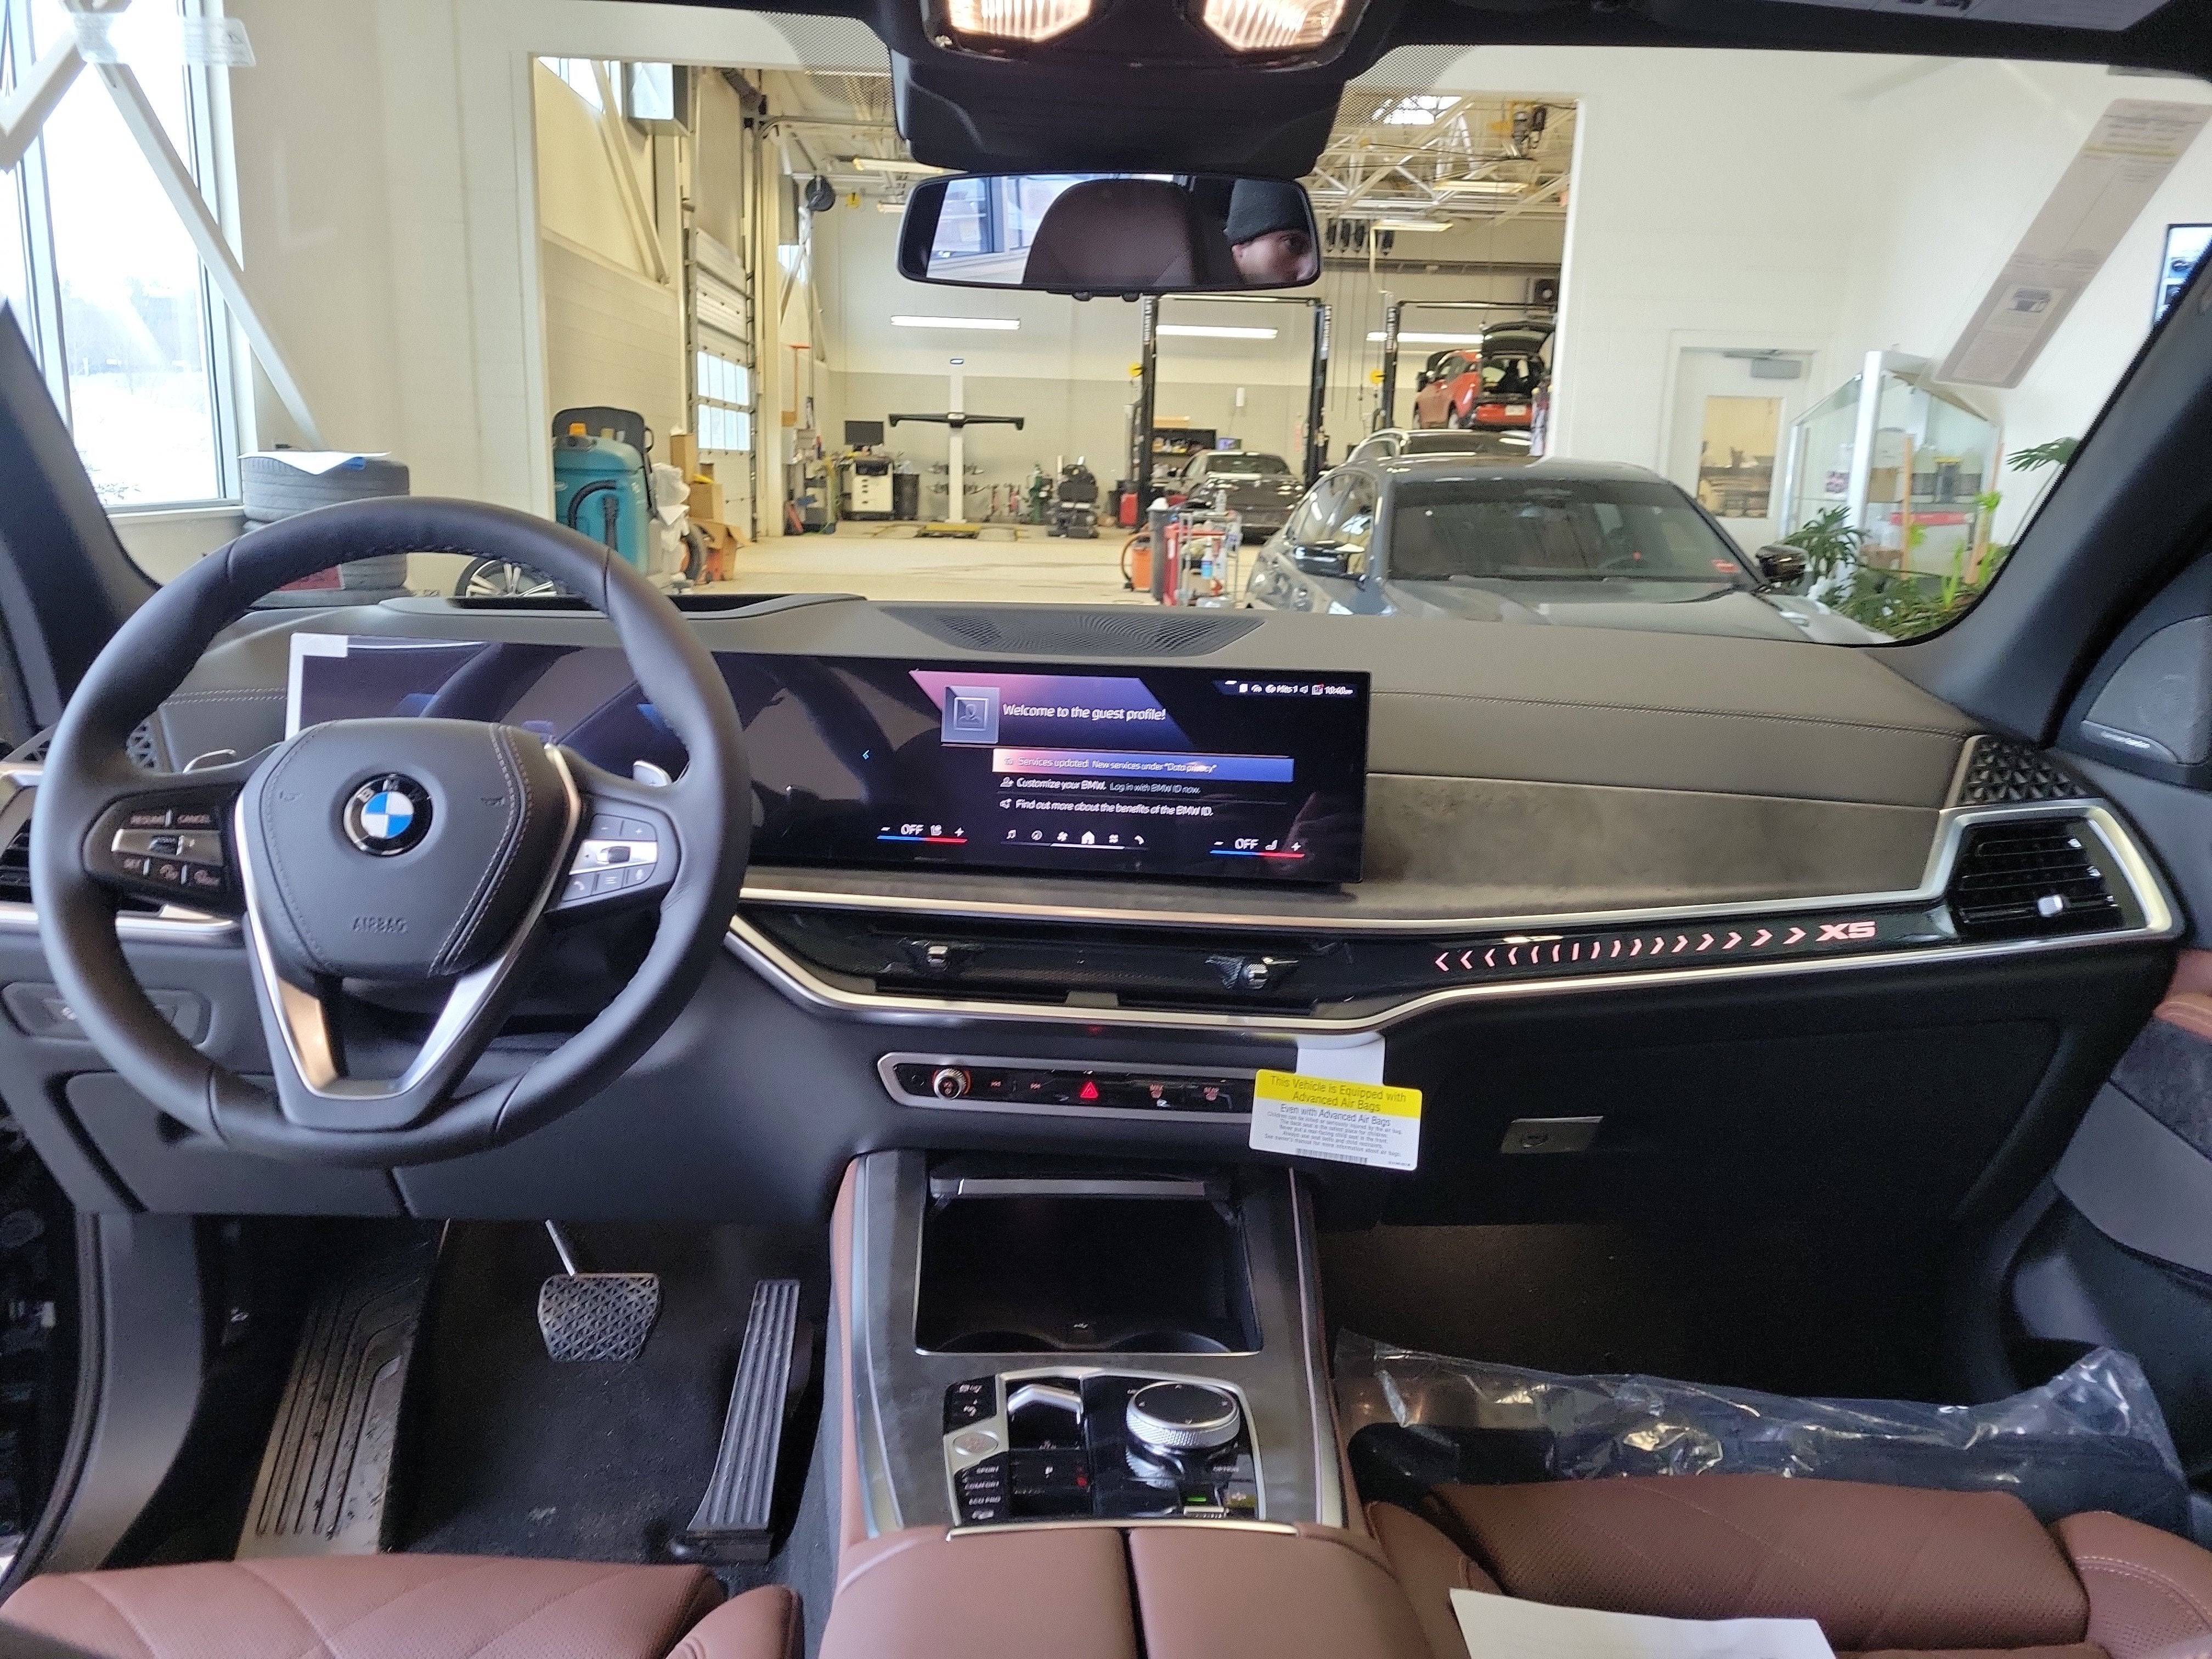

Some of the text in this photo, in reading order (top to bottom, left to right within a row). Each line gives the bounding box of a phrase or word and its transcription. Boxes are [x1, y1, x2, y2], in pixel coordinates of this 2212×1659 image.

[1002, 703, 1166, 722] Welcome to the guest profile!
[1018, 757, 1053, 767] Services
[1092, 760, 1109, 769] New
[1110, 761, 1141, 770] services
[1142, 761, 1163, 771] under
[1016, 777, 1060, 788] Customize
[1061, 780, 1080, 791] your
[1081, 780, 1107, 791] BMW.
[1109, 782, 1125, 793] Log
[1126, 782, 1133, 792] in
[1134, 783, 1150, 792] with
[1150, 783, 1173, 793] BMW
[1172, 784, 1182, 793] ID
[1015, 799, 1035, 809] Find
[1036, 800, 1051, 810] out
[1051, 802, 1074, 811] more
[1074, 801, 1100, 812] about
[1101, 802, 1115, 812] the
[1115, 803, 1150, 814] benefits
[1150, 804, 1160, 815] of
[1160, 804, 1175, 815] the
[1176, 805, 1200, 816] BMW
[900, 823, 924, 835] OFF
[1234, 838, 1259, 849] OFF
[1815, 921, 1876, 941] X5
[1269, 1075, 1407, 1102] This Vehicle is Equipped with
[1293, 1091, 1381, 1113] Advanced Air Bags
[1280, 1104, 1391, 1127] Even with Advanced Air Bags
